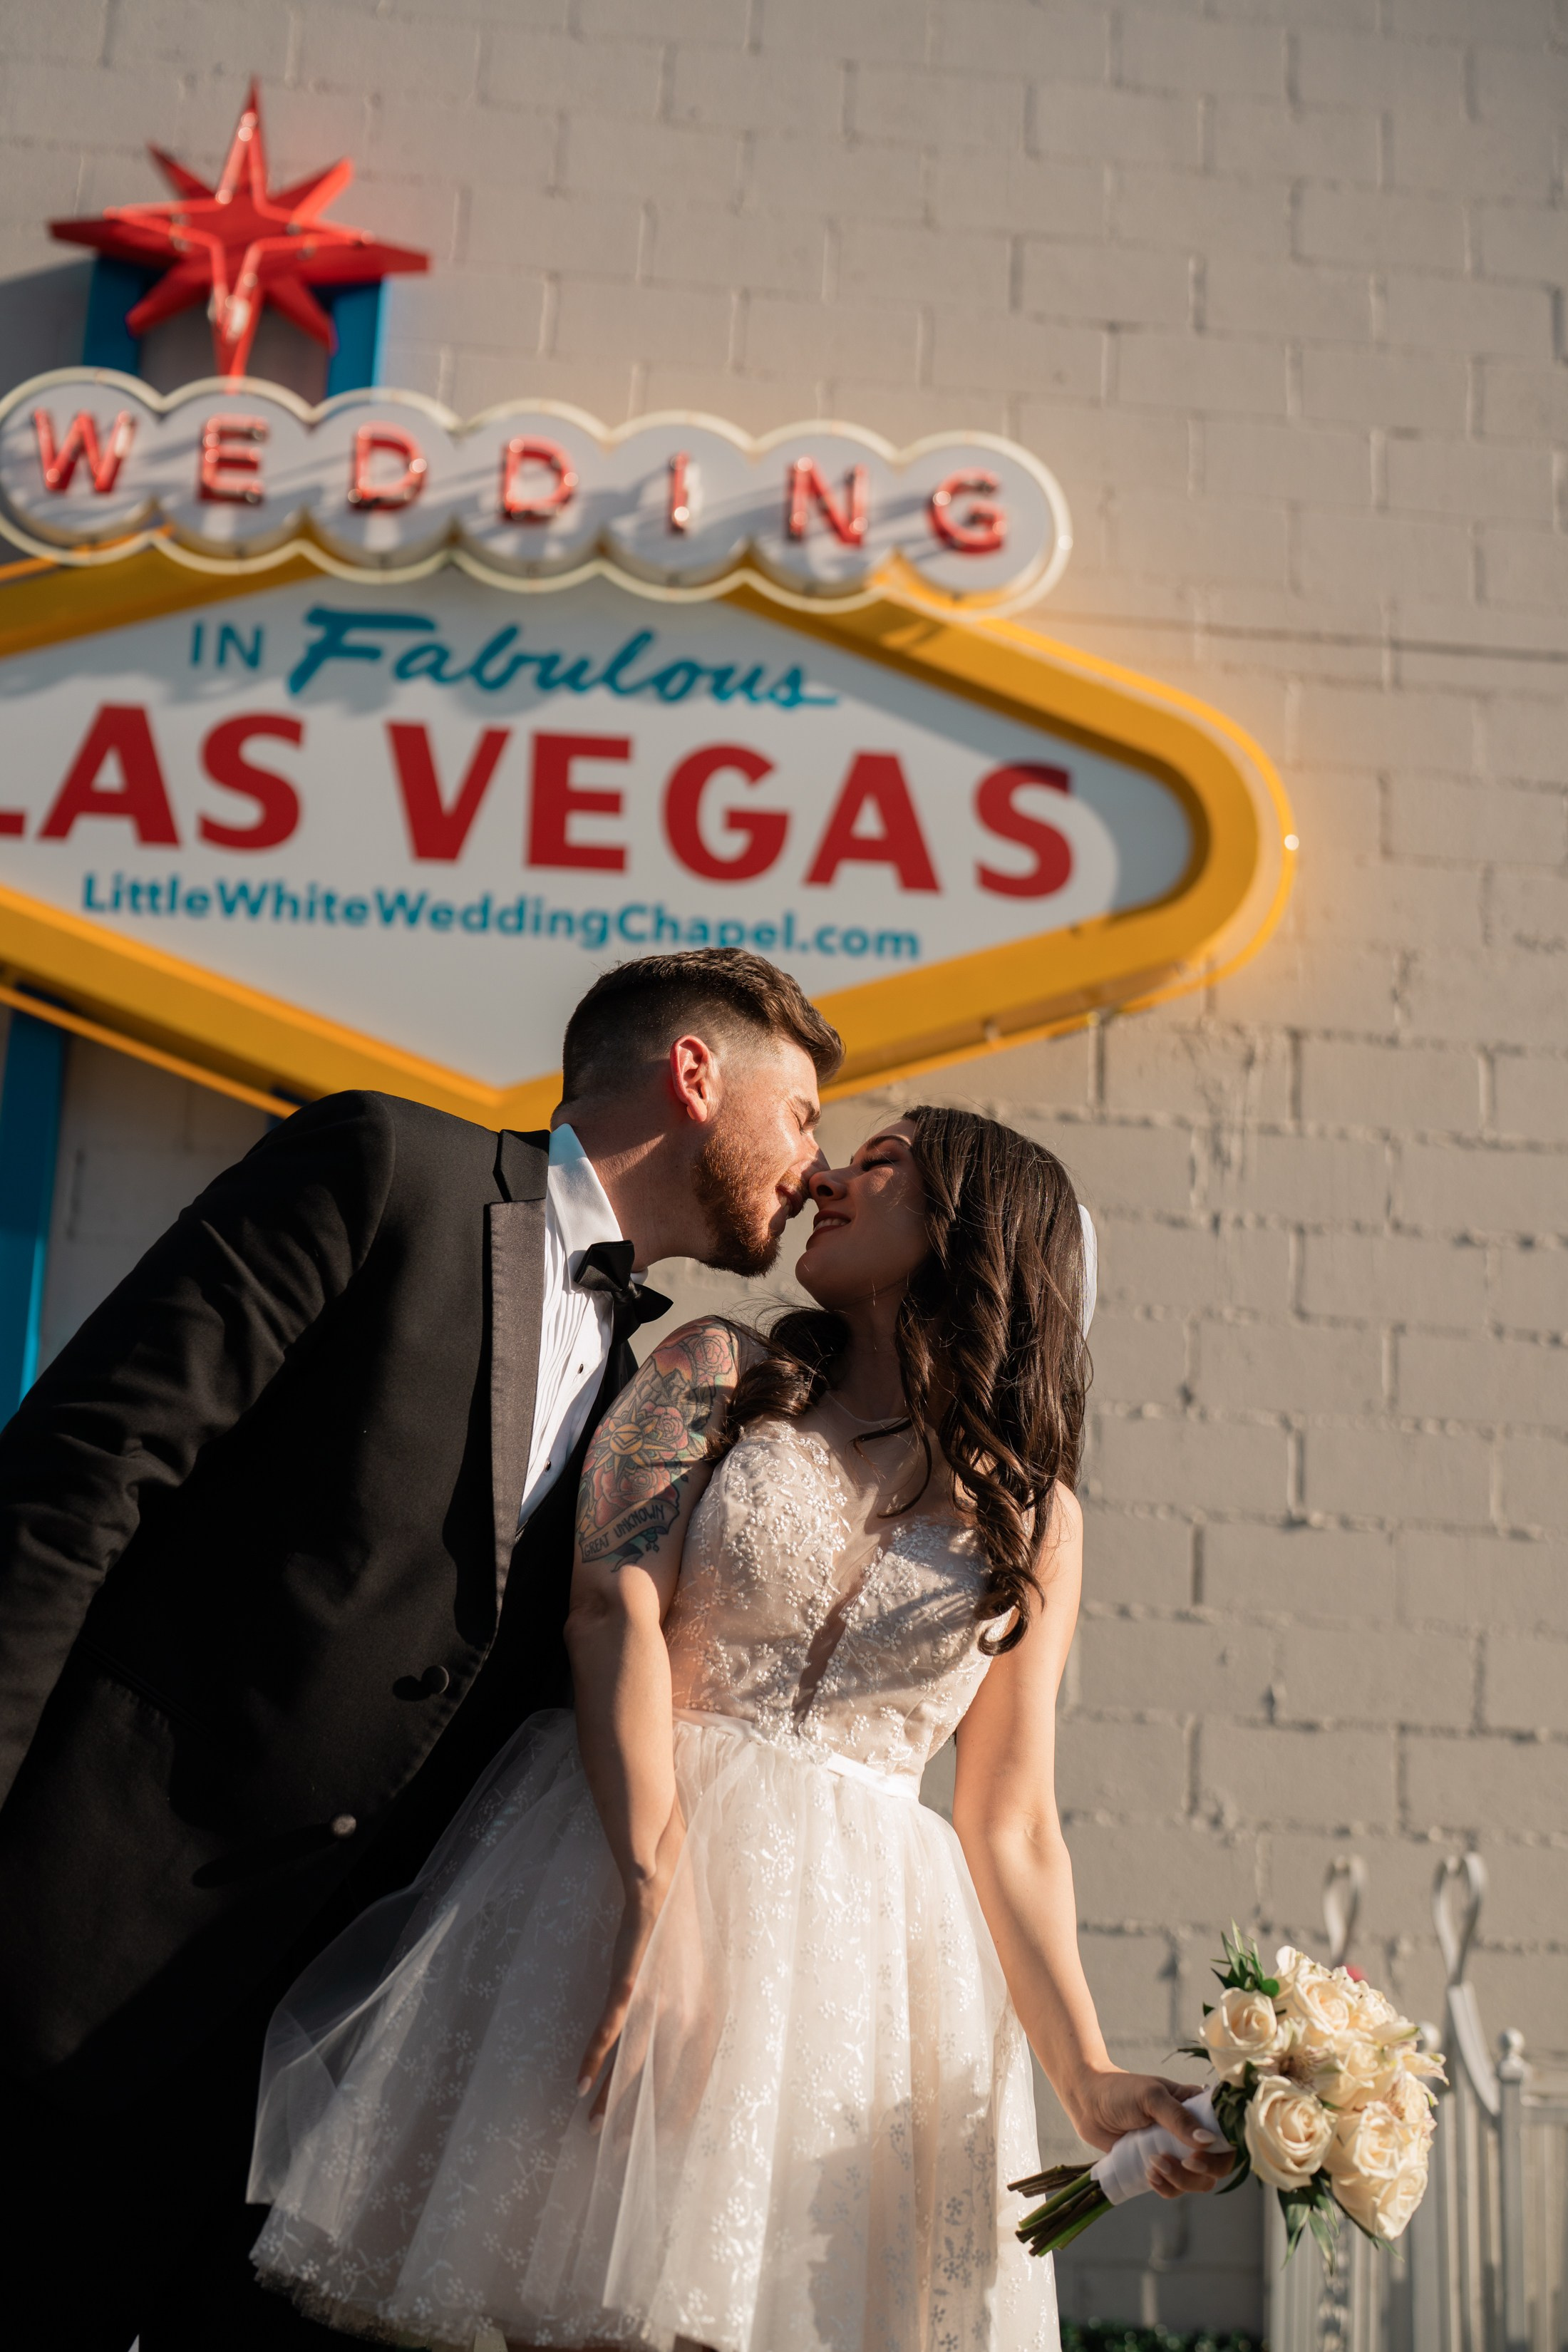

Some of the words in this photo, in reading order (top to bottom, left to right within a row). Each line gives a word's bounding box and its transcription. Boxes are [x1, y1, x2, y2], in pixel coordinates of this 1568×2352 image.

[33, 407, 1006, 555] WEDDING
[190, 619, 264, 669] IN
[287, 604, 839, 708] Fabulous
[0, 701, 305, 851] AS
[385, 721, 1073, 900] VEGAS
[82, 871, 920, 959] LittleWhiteWeddingChapel.com
[584, 1532, 610, 1557] GREAT
[614, 1503, 665, 1538] UNKNOWN
